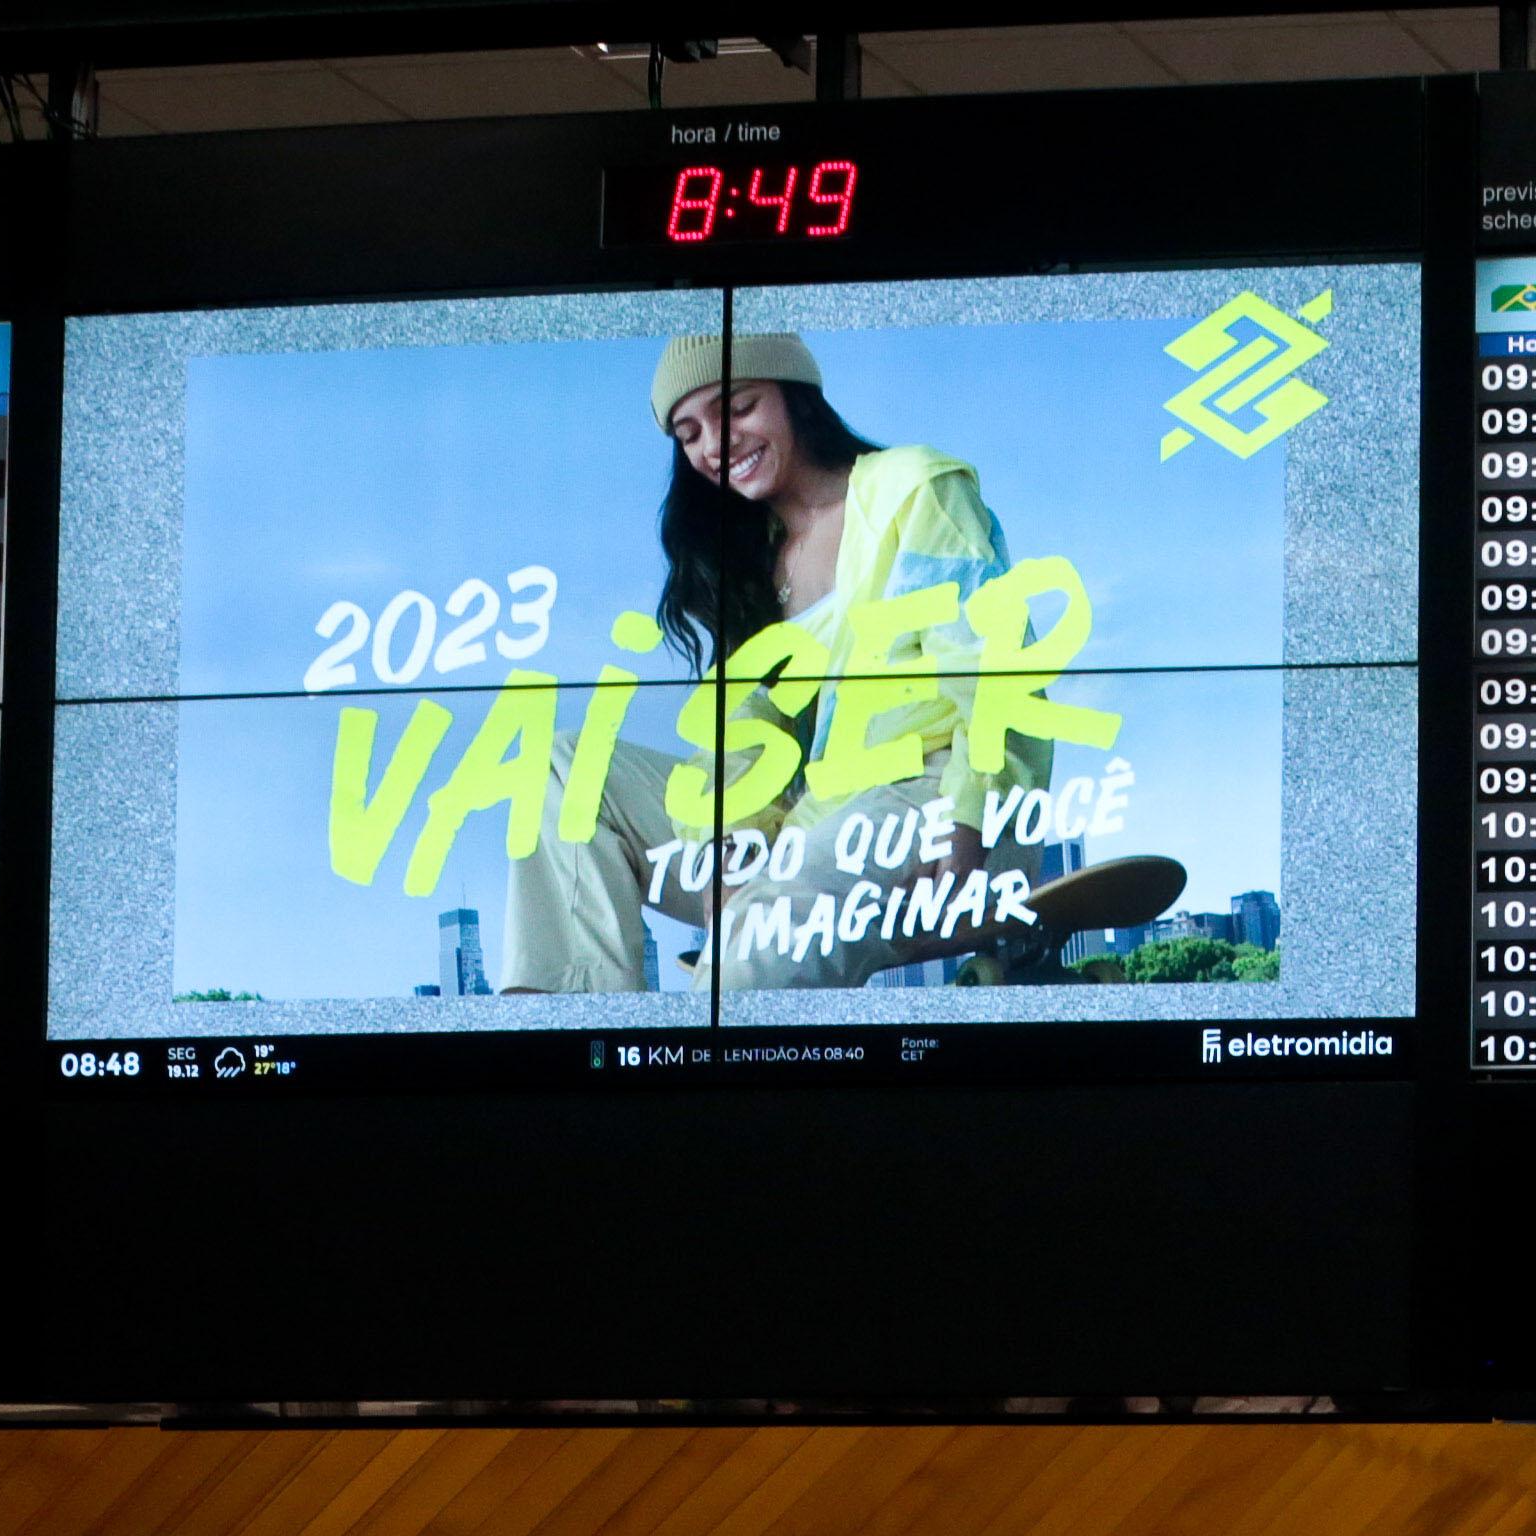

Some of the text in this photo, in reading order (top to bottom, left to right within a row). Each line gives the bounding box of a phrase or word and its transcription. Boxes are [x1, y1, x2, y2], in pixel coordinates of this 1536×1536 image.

[671, 125, 716, 144] hora
[738, 122, 781, 142] time
[667, 160, 858, 242] 8:49
[303, 565, 558, 698] 2023
[666, 556, 1123, 827] SER
[645, 758, 1137, 904] TUDO QUE VOCÊ
[713, 869, 1044, 964] IMAGINAR
[168, 1047, 196, 1060] SEG
[901, 1050, 925, 1061] CET
[1228, 1030, 1393, 1056] eletromidia
[61, 1052, 140, 1077] 08:48
[617, 1046, 641, 1066] 16
[648, 1046, 684, 1065] KM
[692, 1049, 712, 1063] DE
[724, 1046, 800, 1062] LENTIDÃO
[824, 1047, 864, 1061] 08:40
[167, 1064, 199, 1078] 19.12
